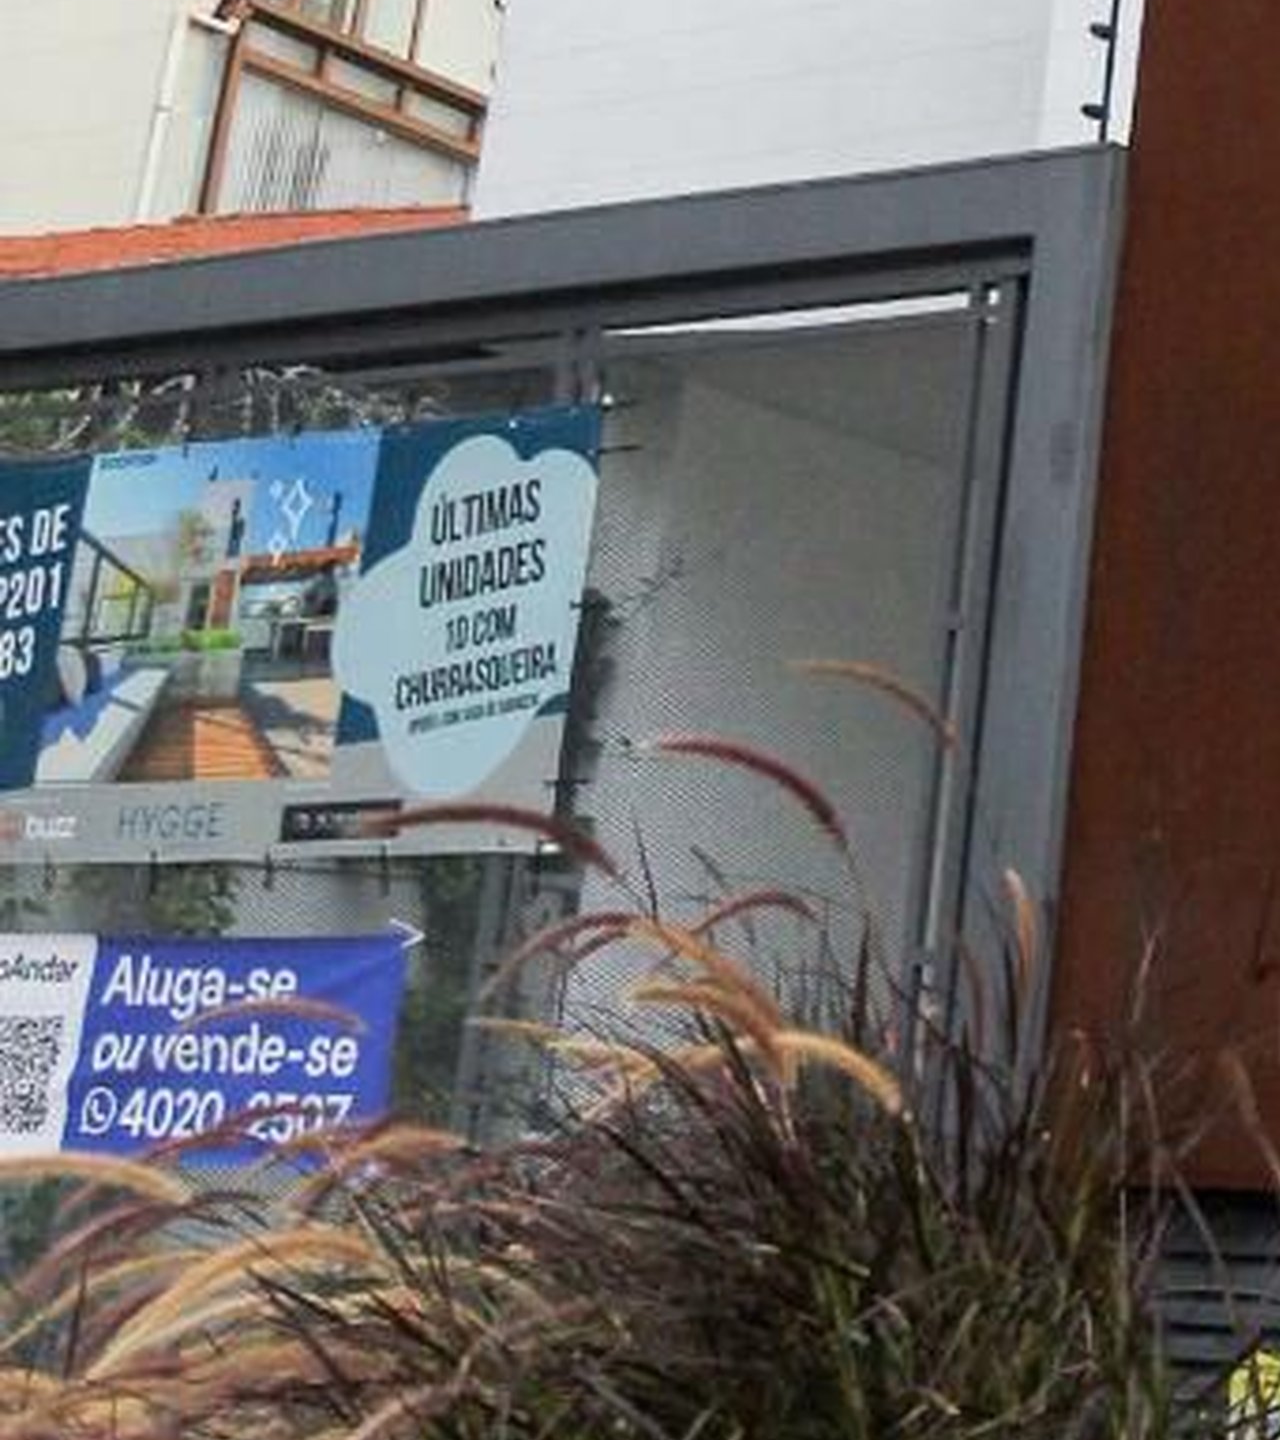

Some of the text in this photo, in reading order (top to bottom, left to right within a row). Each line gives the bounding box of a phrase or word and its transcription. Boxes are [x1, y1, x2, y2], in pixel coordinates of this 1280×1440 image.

[0, 503, 71, 563] S DE
[431, 479, 541, 546] ÚLTIMAS
[420, 538, 546, 609] UNIDADES
[472, 603, 517, 647] COM
[395, 641, 557, 711] CHURRASQUEIRA
[117, 803, 226, 841] HYGGE
[101, 954, 298, 1021] Aluga-se
[93, 1022, 358, 1077] ou vende-se
